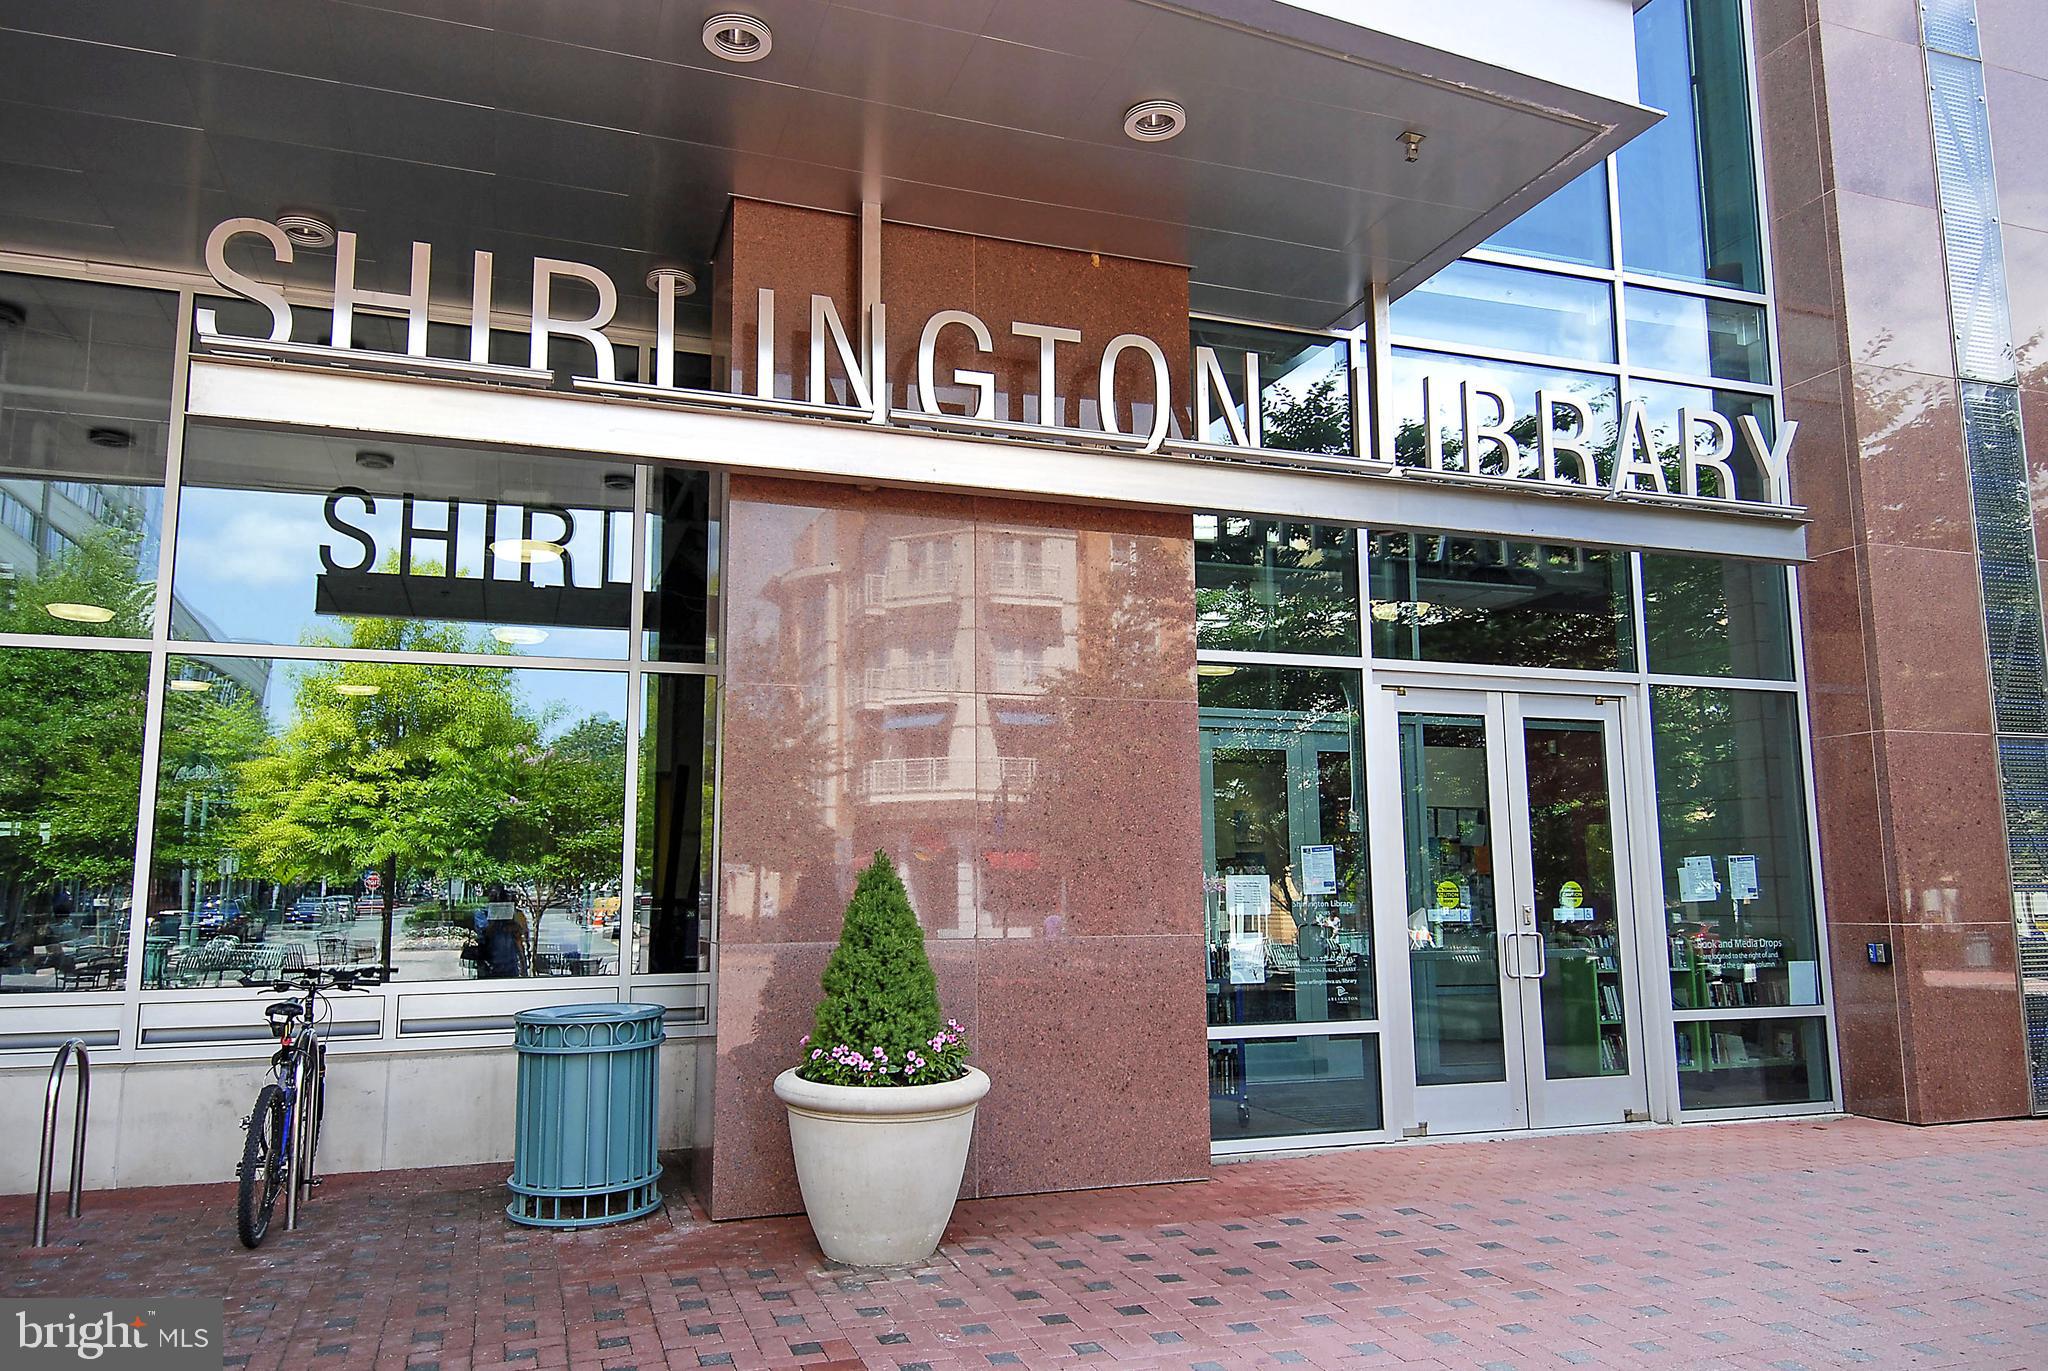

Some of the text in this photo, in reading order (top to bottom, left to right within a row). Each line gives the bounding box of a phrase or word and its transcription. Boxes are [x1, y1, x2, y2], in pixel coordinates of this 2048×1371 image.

[1330, 900, 1354, 908] Library
[1718, 939, 1733, 948] and
[1734, 939, 1758, 948] Media
[1759, 938, 1782, 950] Drops
[1749, 952, 1761, 960] right
